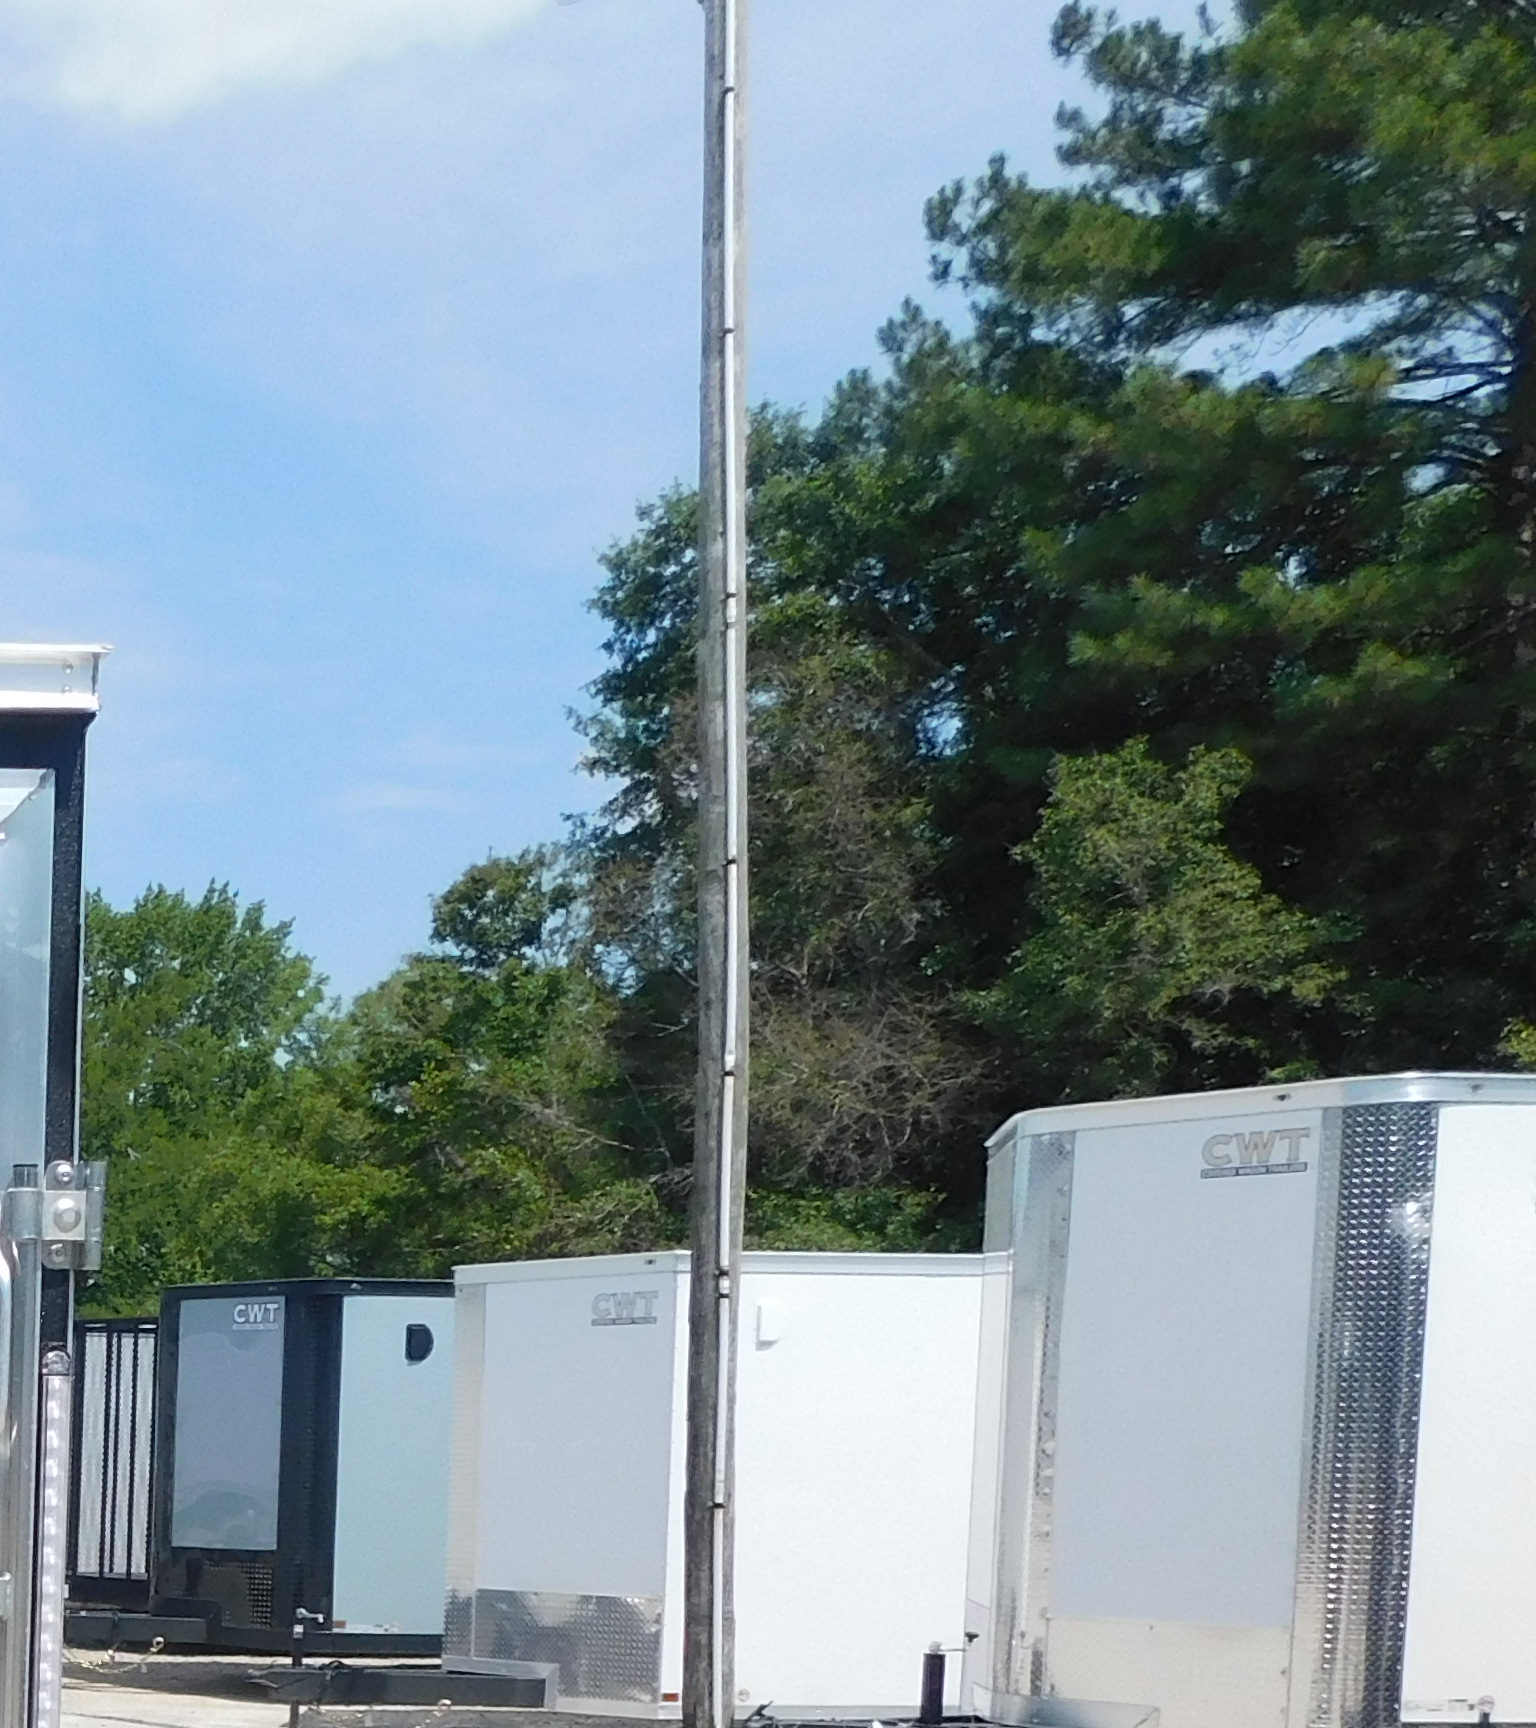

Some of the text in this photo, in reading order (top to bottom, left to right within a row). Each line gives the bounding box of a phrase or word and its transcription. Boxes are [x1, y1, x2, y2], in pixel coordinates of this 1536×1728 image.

[1202, 1127, 1310, 1167] CWT
[233, 1303, 279, 1323] CWT
[592, 1291, 659, 1318] CWT
